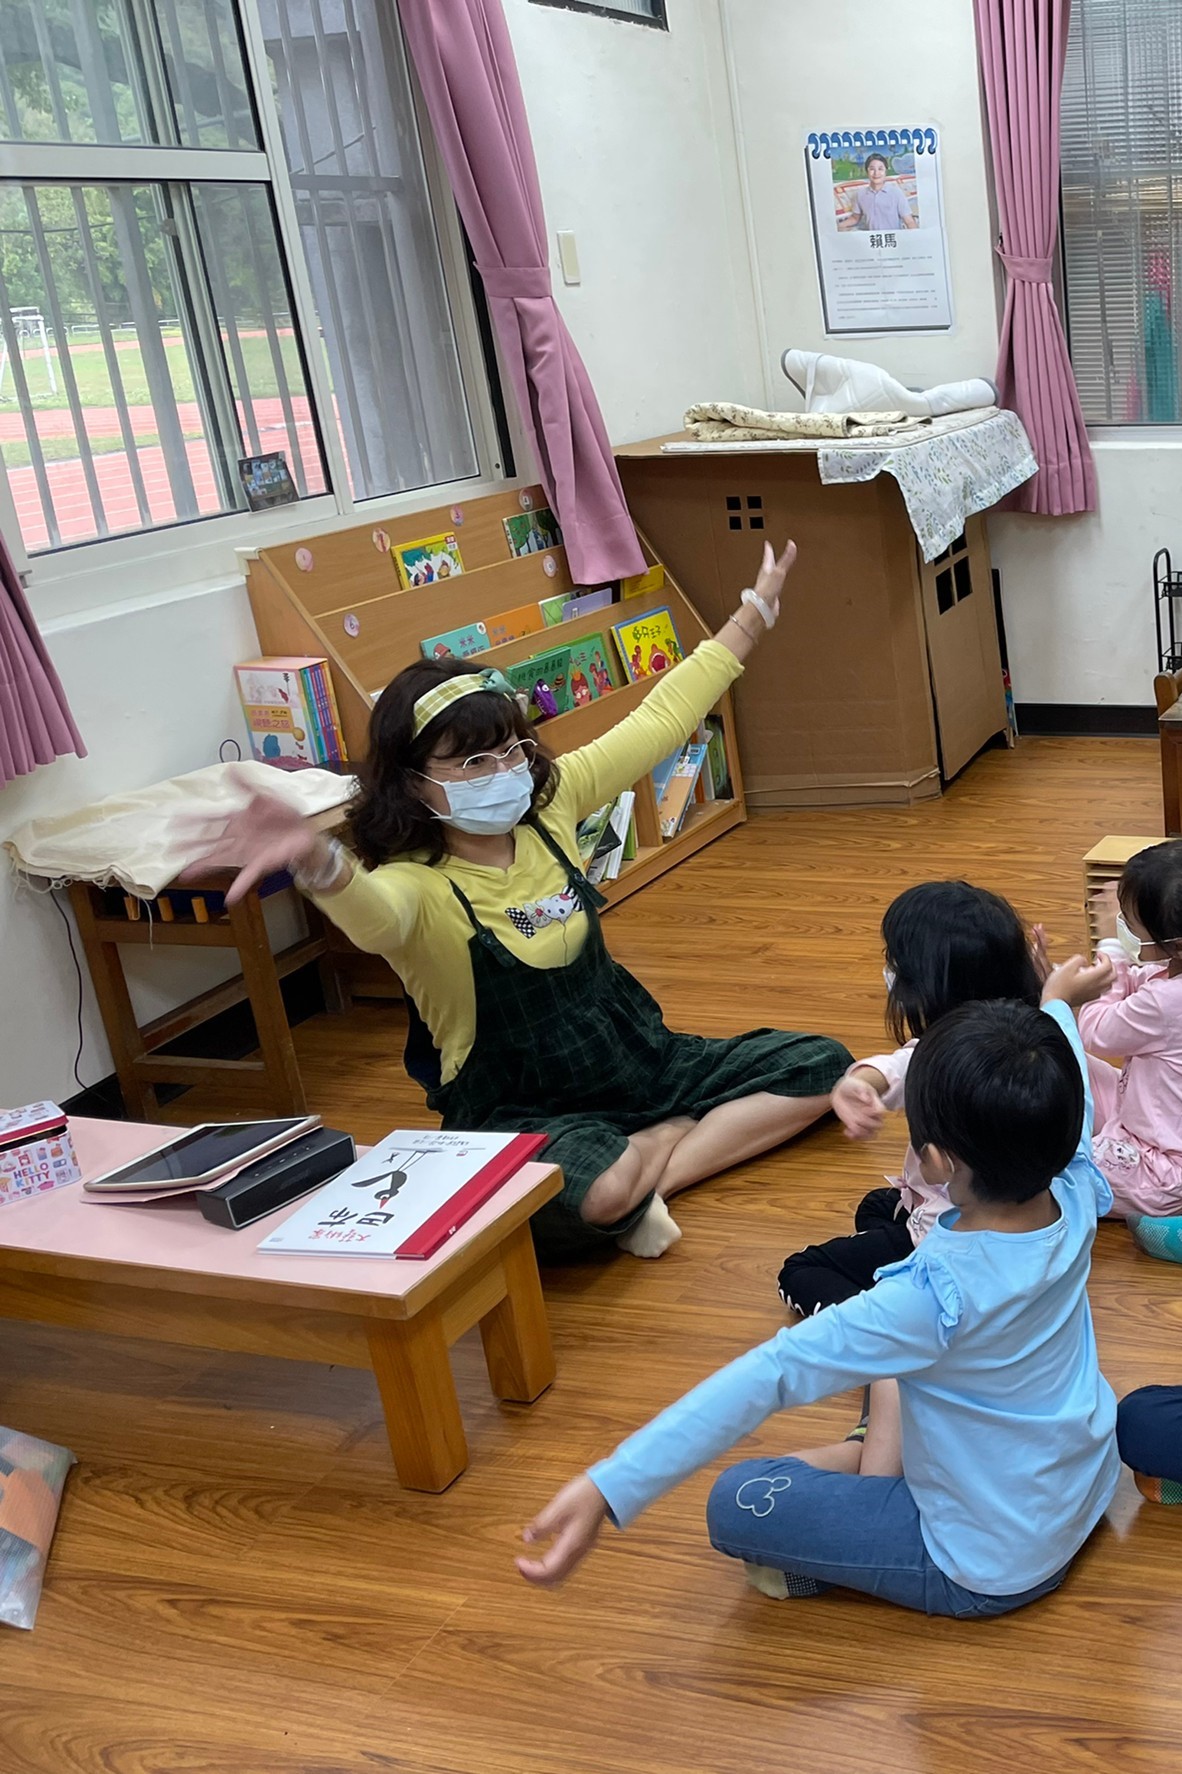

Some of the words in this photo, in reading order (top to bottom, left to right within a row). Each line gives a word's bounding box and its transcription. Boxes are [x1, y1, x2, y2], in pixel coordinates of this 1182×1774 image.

[869, 233, 897, 249] 賴馬
[13, 1162, 49, 1179] HELLO
[15, 1170, 50, 1188] KITTY
[317, 1207, 395, 1227] 巴布
